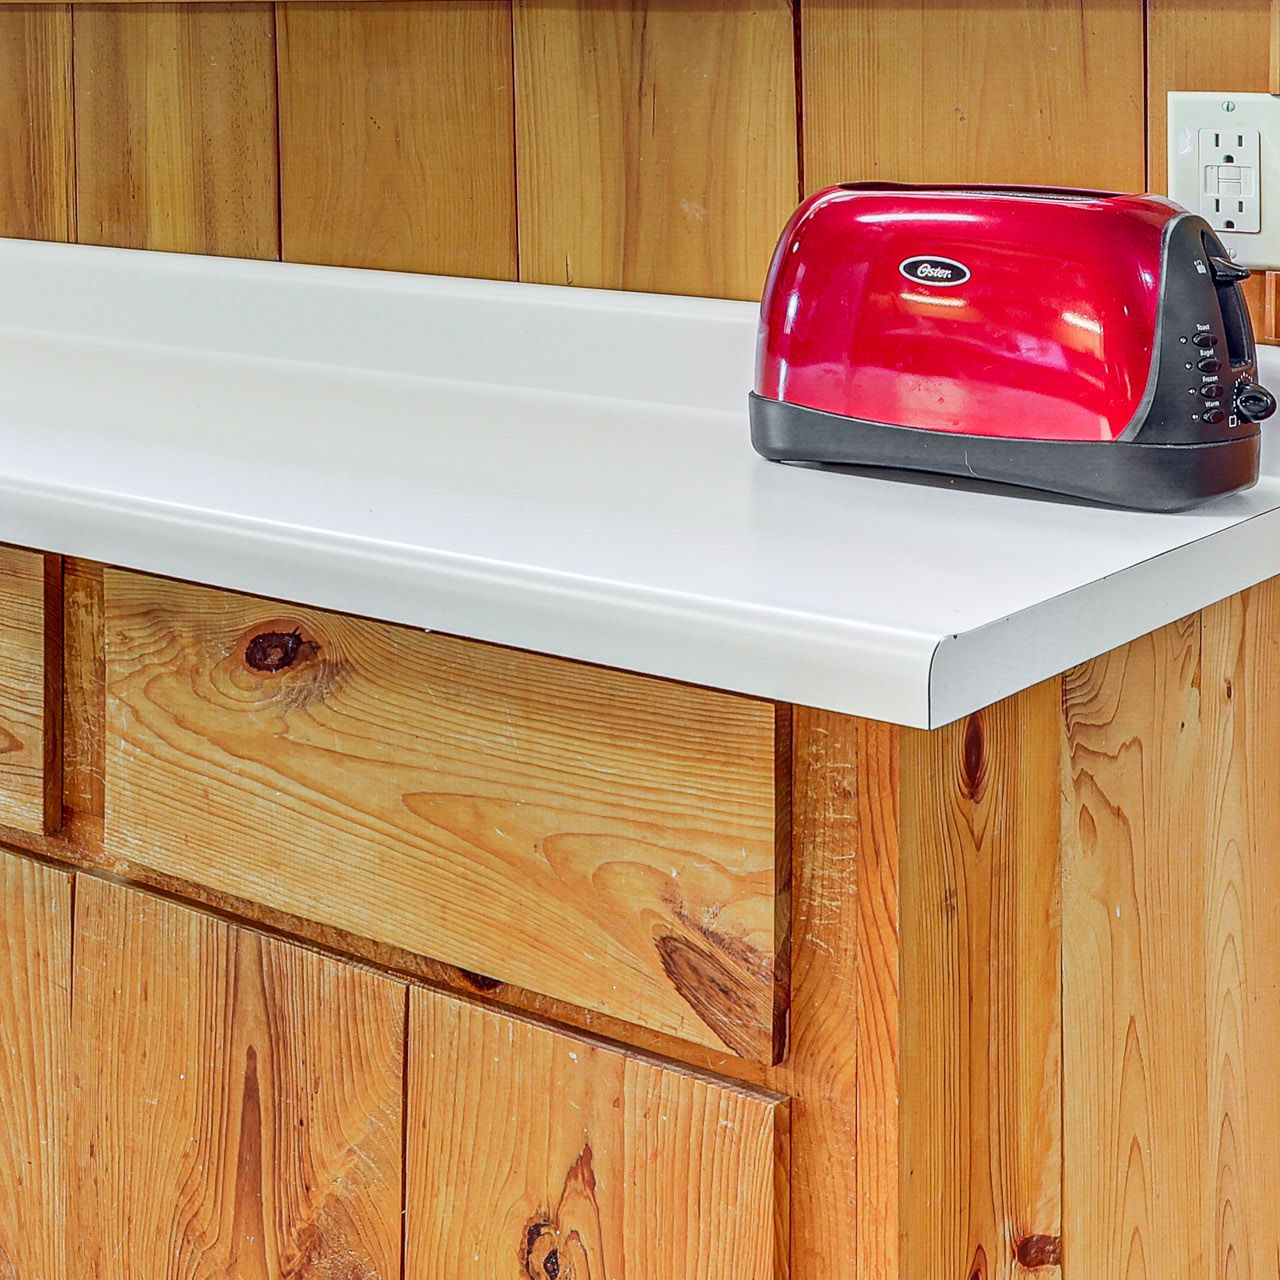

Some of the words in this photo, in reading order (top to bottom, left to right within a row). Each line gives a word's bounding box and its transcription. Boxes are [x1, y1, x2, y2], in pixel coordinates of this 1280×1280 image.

[1196, 323, 1210, 331] Toast
[1200, 348, 1214, 357] Bagel
[1202, 375, 1219, 383] Frozen
[1205, 400, 1220, 408] Warm
